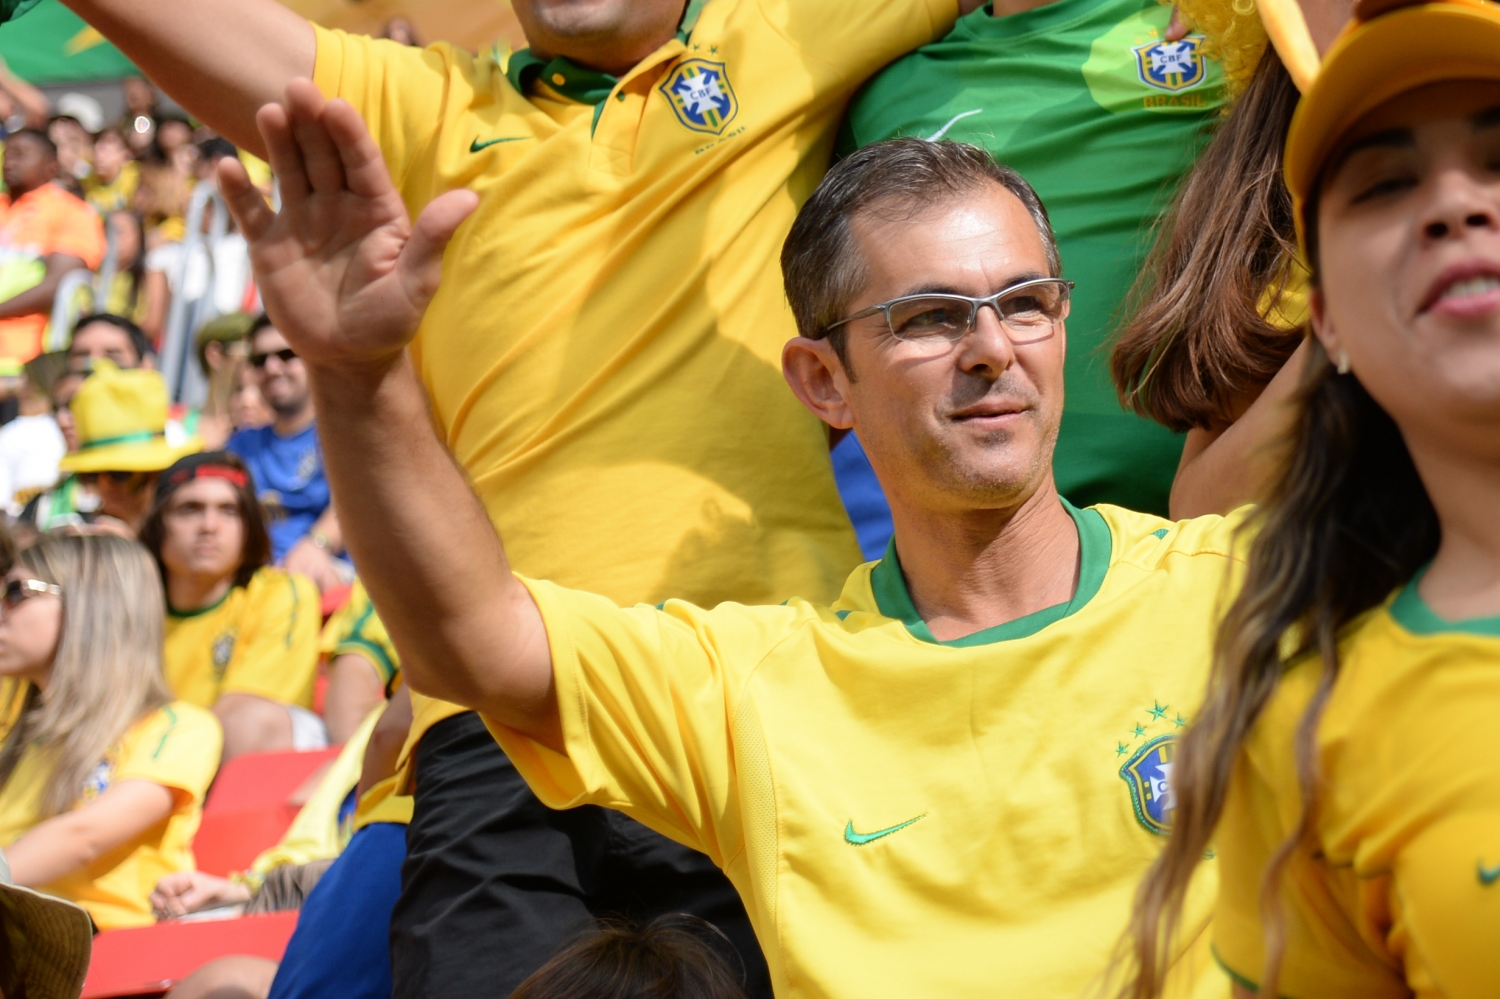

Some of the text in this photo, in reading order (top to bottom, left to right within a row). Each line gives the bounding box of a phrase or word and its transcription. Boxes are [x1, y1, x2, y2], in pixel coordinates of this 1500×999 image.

[1159, 54, 1183, 65] CBF
[690, 87, 712, 101] CBF
[1143, 93, 1207, 109] BRASIL
